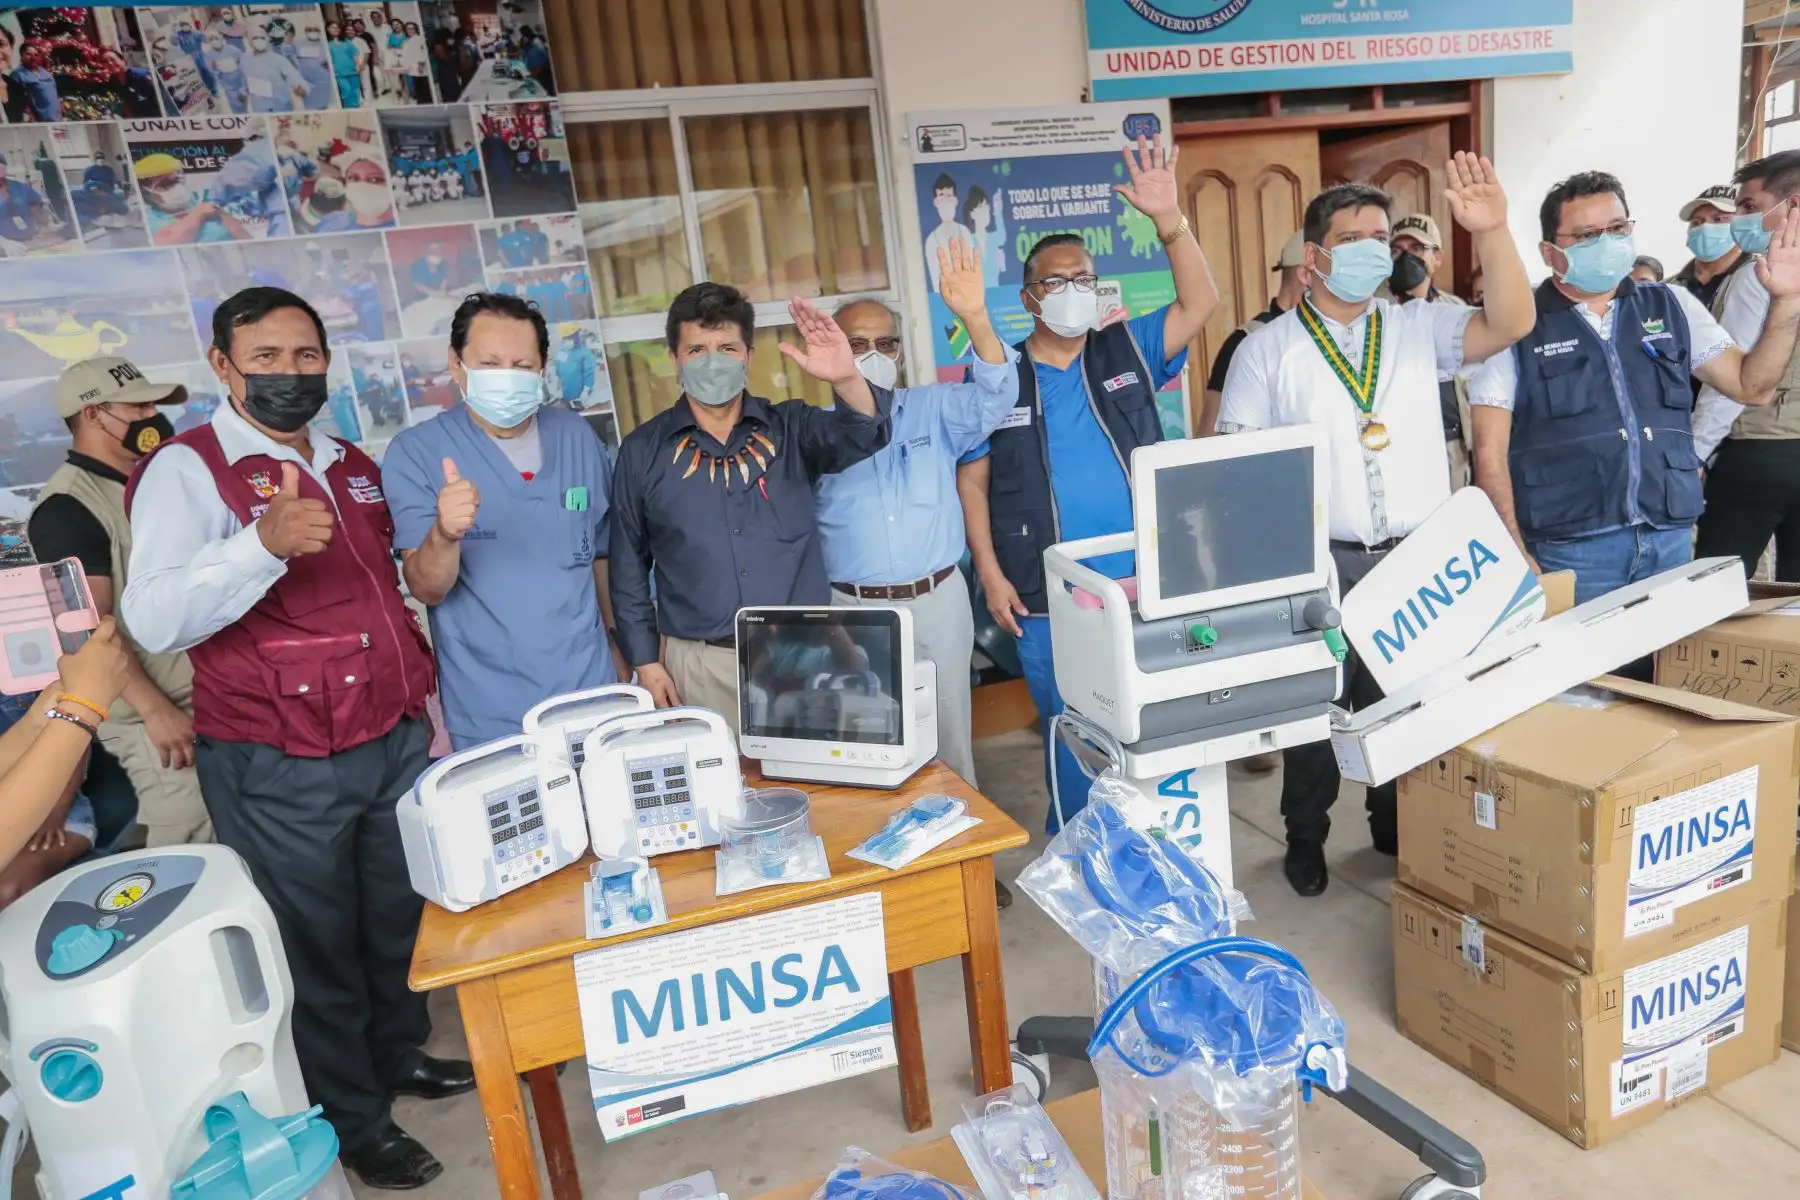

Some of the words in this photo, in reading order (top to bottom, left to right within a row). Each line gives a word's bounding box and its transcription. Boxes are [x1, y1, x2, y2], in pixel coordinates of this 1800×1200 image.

[1197, 16, 1213, 31] DE
[1301, 13, 1348, 26] HOSPITAL
[1350, 11, 1381, 23] SANTA
[1383, 9, 1410, 21] ROSA
[1107, 50, 1191, 73] UNIDAD
[1200, 48, 1224, 67] DE
[1231, 43, 1315, 66] GESTION
[1321, 41, 1356, 61] DEL
[1366, 36, 1433, 59] RIESGO
[1439, 34, 1462, 54] DE
[1468, 29, 1555, 52] DESASTRE
[124, 117, 203, 132] UNATE
[195, 157, 214, 168] DE
[1008, 188, 1035, 204] TODO
[1036, 187, 1050, 202] LO
[1050, 186, 1070, 202] QUE
[1070, 184, 1084, 199] SE
[1084, 183, 1112, 198] SABE
[1012, 204, 1046, 220] SOBRE
[1046, 203, 1061, 218] LA
[1061, 199, 1110, 216] VARIANTE
[78, 388, 101, 401] PERU
[1372, 539, 1499, 664] MINSA
[1639, 799, 1751, 870] MINSA
[611, 944, 861, 1044] MINSA
[1631, 956, 1743, 1030] MINSA
[850, 1046, 882, 1059] Siempre
[862, 1053, 884, 1065] pueblo
[1620, 1095, 1632, 1106] UN
[1221, 1144, 1242, 1153] 2400
[1223, 1165, 1244, 1174] 2200
[1225, 1185, 1245, 1194] 2000
